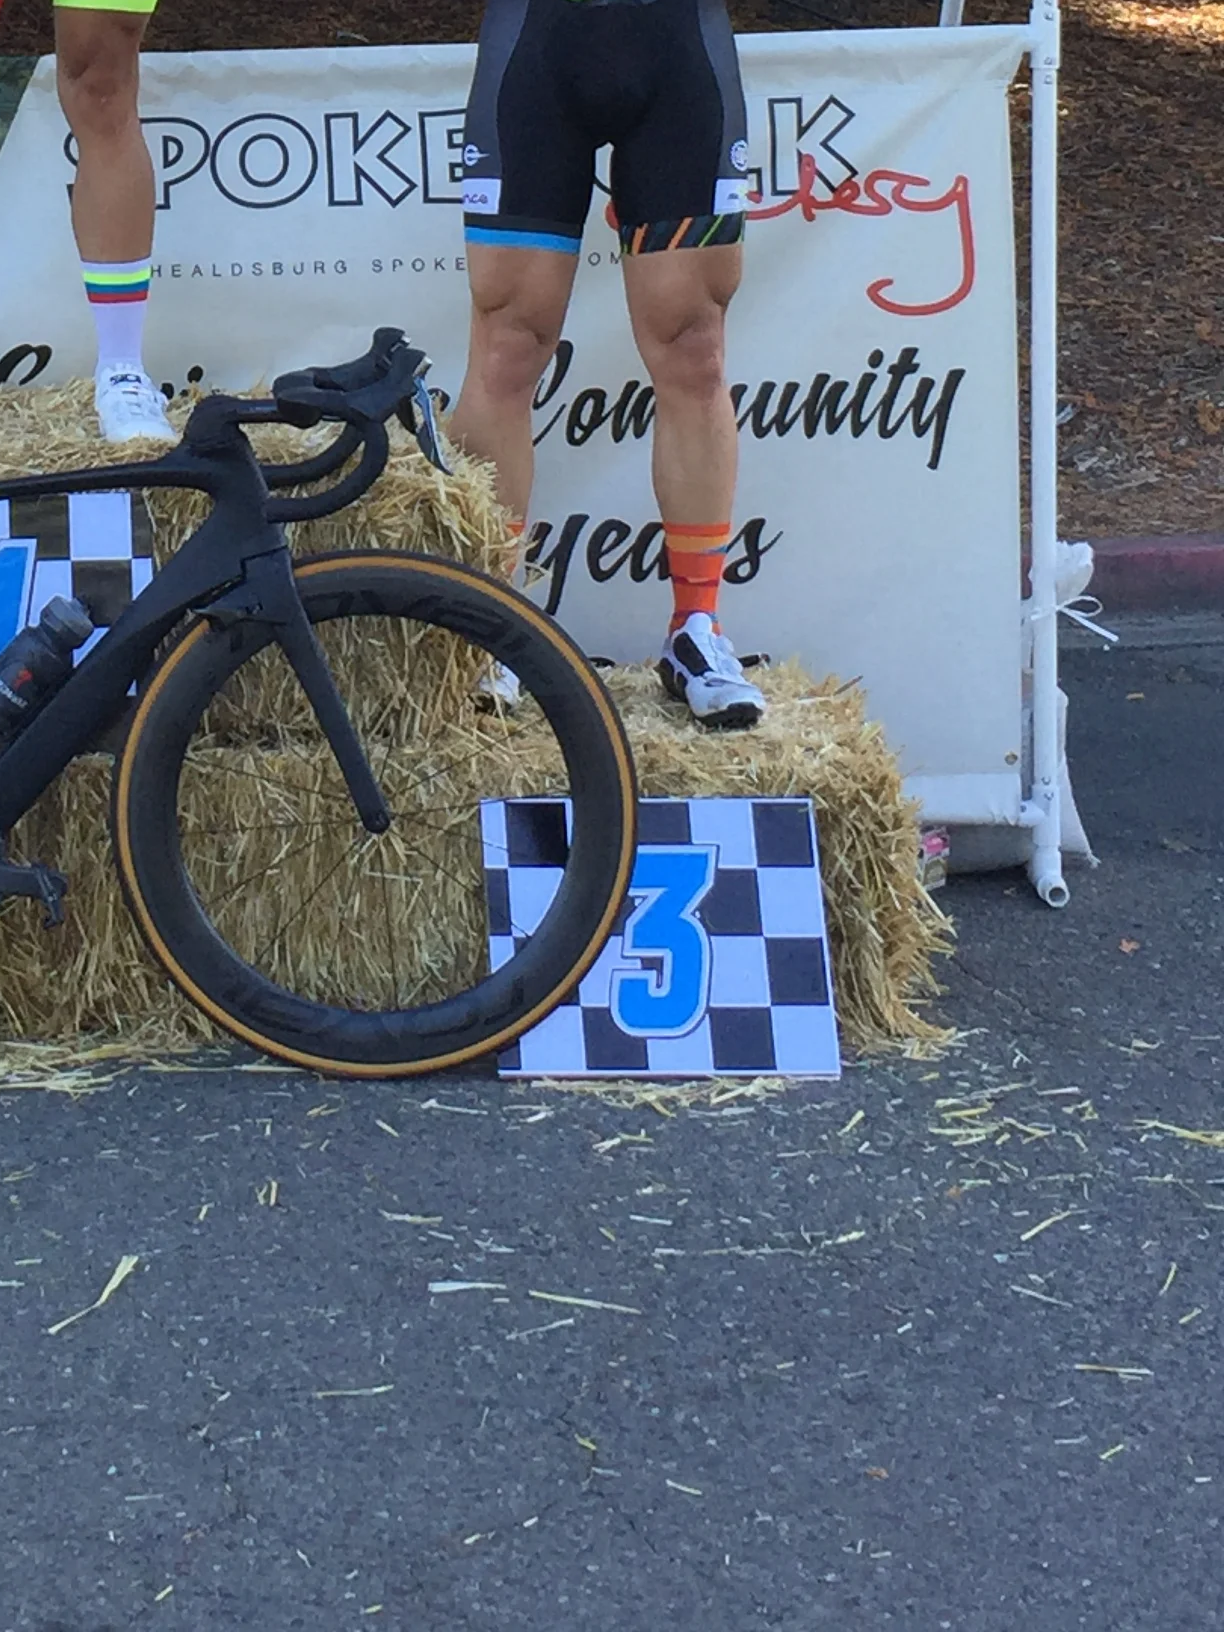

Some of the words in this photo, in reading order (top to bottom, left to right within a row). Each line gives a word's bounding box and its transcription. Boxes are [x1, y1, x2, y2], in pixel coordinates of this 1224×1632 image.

[150, 261, 348, 278] HEALDSBURG
[524, 512, 784, 617] yeas
[609, 842, 721, 1040] 3
